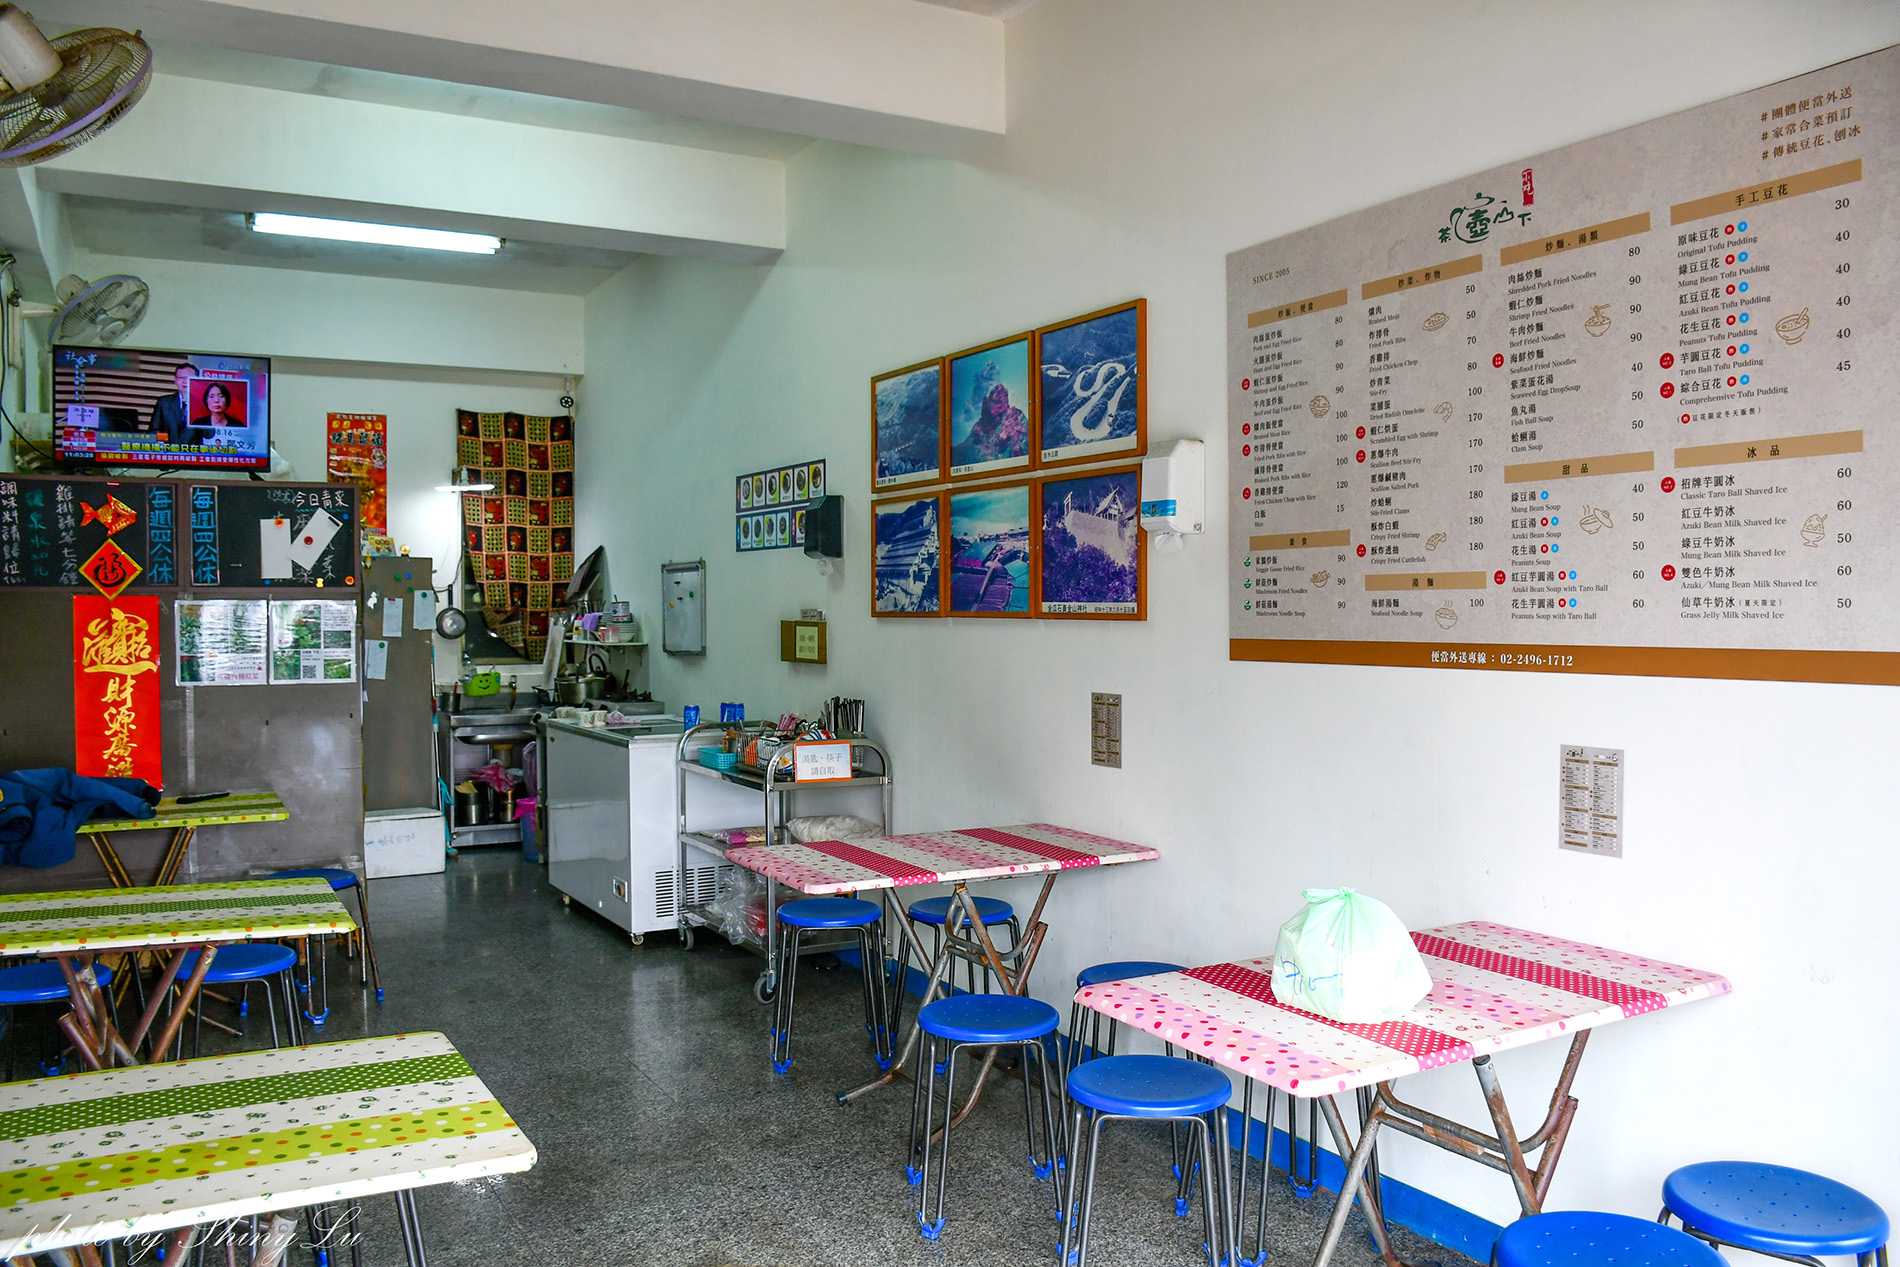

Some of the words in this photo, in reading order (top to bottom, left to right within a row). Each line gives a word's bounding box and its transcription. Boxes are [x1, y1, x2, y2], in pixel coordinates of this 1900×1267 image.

[1735, 184, 1789, 206] 手工豆花
[1835, 198, 1850, 210] 30
[1678, 227, 1719, 246] 原味豆花
[1835, 231, 1850, 241] 40
[1545, 230, 1598, 253] 炒麵、湯類
[1677, 246, 1706, 258] Original
[1708, 241, 1725, 252] Tofu
[1726, 235, 1758, 248] Pudding
[1629, 247, 1640, 256] 80
[1678, 258, 1720, 276] 綠豆豆花
[1836, 263, 1850, 274] 40
[1253, 273, 1273, 285] SINCE
[1275, 268, 1290, 279] 2005
[1398, 270, 1441, 287] 炒菜、炸物
[1508, 268, 1543, 285] 肉絲炒麵
[1629, 276, 1641, 285] 90
[1466, 285, 1476, 294] 50
[1679, 288, 1720, 305] 紅豆豆花
[1836, 296, 1851, 306] 40
[1509, 295, 1543, 311] 蝦仁炒麵
[1278, 302, 1314, 318] 炒飯、便當
[1630, 304, 1642, 314] 90
[1335, 316, 1343, 324] 80
[1466, 310, 1476, 320] 50
[1510, 322, 1544, 337] 牛肉炒麵
[1679, 318, 1721, 334] 花生豆花
[1369, 328, 1390, 340] 炸排骨
[1630, 333, 1642, 342] 90
[1837, 329, 1851, 339] 40
[1335, 339, 1344, 348] 80
[1467, 336, 1476, 345] 70
[1510, 349, 1544, 364] 海鮮炒麵
[1680, 348, 1721, 364] 芋圓豆花
[1335, 362, 1344, 371] 90
[1467, 362, 1477, 371] 80
[1631, 362, 1643, 371] 40
[1837, 361, 1851, 371] 45
[1369, 376, 1390, 388] 炒青菜
[1511, 374, 1554, 390] 紫菜蛋花湯
[1680, 378, 1721, 393] 綜合豆花
[1336, 385, 1344, 394] 90
[1468, 387, 1482, 396] 100
[1632, 391, 1643, 400] 50
[1253, 396, 1283, 409] 牛肉蛋炒飯
[1370, 400, 1391, 412] 菜脯蛋
[1336, 410, 1348, 419] 100
[1511, 404, 1536, 416] 魚丸湯
[1468, 413, 1483, 422] 170
[1370, 423, 1399, 436] 蝦仁烘蛋
[1632, 420, 1643, 429] 50
[1336, 434, 1348, 443] 100
[1511, 431, 1537, 443] 蛤蜊湯
[1469, 438, 1483, 448] 170
[1747, 445, 1780, 458] 冰品
[1336, 457, 1348, 466] 100
[1469, 465, 1483, 473] 170
[1562, 464, 1589, 475] 甜品
[1837, 468, 1852, 477] 60
[1336, 480, 1348, 489] 120
[1681, 475, 1735, 490] 招牌芋圓冰
[1632, 484, 1644, 492] 40
[1680, 491, 1706, 500] Classic
[1708, 490, 1726, 498] Taro
[1728, 488, 1742, 497] Ball
[1745, 486, 1773, 496] Shaved
[1775, 485, 1788, 494] Ice
[292, 490, 348, 508] 今日青菜
[1469, 490, 1483, 499] 180
[1511, 491, 1536, 503] 綠豆湯
[1371, 497, 1392, 507] 炒蛤蜊
[1837, 500, 1852, 510] 60
[1336, 504, 1344, 512] 15
[1511, 506, 1527, 514] Mung
[1529, 504, 1545, 512] Bean
[1546, 503, 1561, 512] Soup
[1681, 505, 1735, 519] 紅豆牛奶冰
[1254, 510, 1266, 519] 白飯
[1632, 513, 1644, 521] 50
[1469, 516, 1483, 525] 180
[1511, 518, 1537, 529] 紅豆湯
[1371, 521, 1399, 532] 酥炸白蝦
[149, 487, 173, 584] 每週四公休
[192, 488, 218, 584] 每週四公休
[1837, 533, 1852, 543] 50
[1469, 542, 1484, 551] 180
[1633, 542, 1644, 550] 50
[1681, 536, 1735, 549] 綠豆牛奶冰
[1371, 546, 1399, 555] 酥炸透抽
[1511, 545, 1537, 556] 花生湯
[1337, 555, 1346, 563] 90
[1633, 571, 1644, 579] 60
[1681, 566, 1735, 579] 雙色牛奶冰
[1837, 566, 1852, 576] 60
[1337, 578, 1346, 586] 90
[1511, 572, 1555, 582] 紅豆芋圓湯
[1412, 578, 1434, 587] 湯麵
[1337, 601, 1346, 609] 90
[1371, 599, 1399, 608] 海鮮湯麵
[1470, 599, 1484, 607] 100
[1511, 599, 1555, 609] 花生芋圓湯
[1633, 600, 1644, 608] 60
[1681, 596, 1735, 608] 仙草牛奶冰
[1837, 599, 1852, 608] 50
[1702, 612, 1720, 620] Jelly
[1500, 654, 1573, 666] 02-2496-1712
[811, 767, 835, 775] 請自取
